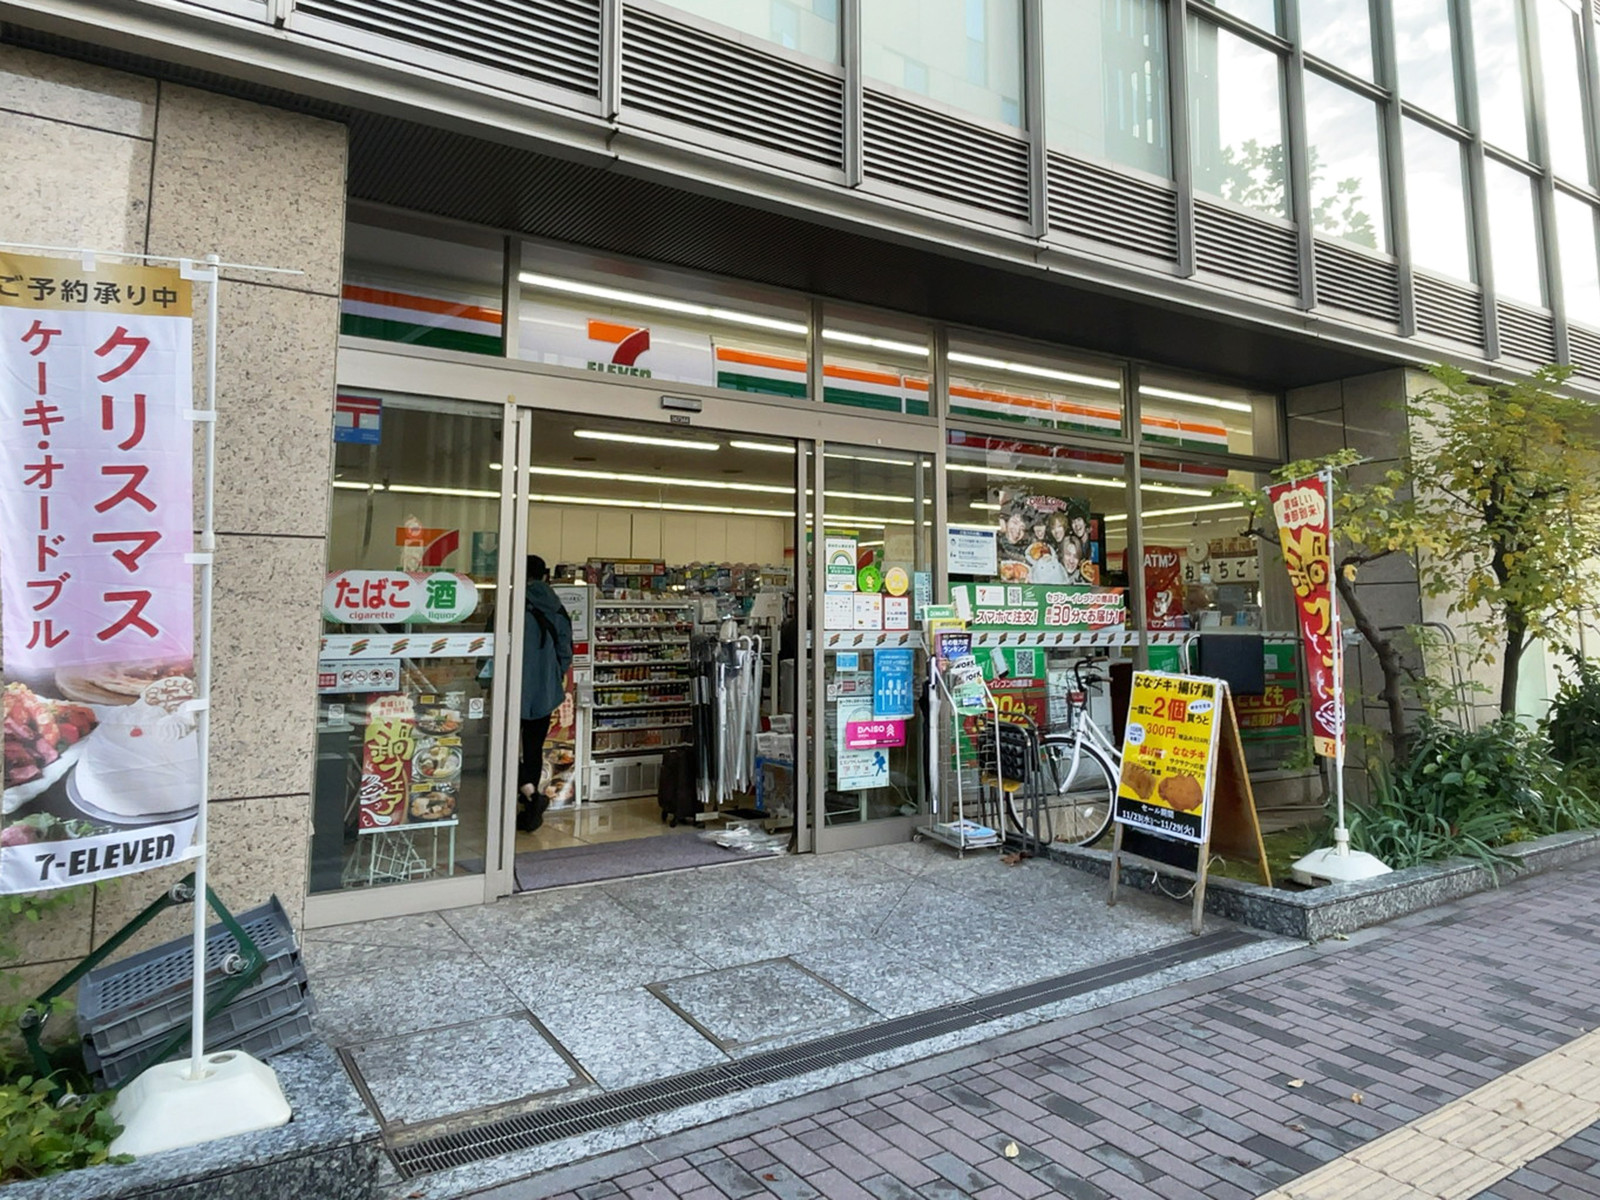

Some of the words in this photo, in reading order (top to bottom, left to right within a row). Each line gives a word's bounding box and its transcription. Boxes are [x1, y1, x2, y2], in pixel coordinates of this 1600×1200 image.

[0, 275, 177, 308] ご予約承り中
[21, 320, 70, 649] ケーキ・オードブル
[92, 326, 162, 641] クリスマス
[1283, 495, 1312, 511] 美味しい
[335, 578, 410, 609] たばこ
[426, 580, 457, 609] 酒
[349, 612, 395, 620] cigarette
[428, 611, 457, 619] liquor
[976, 611, 1038, 625] スマホで注文!
[857, 725, 885, 733] DAISO
[1146, 723, 1176, 739] 300円
[1173, 746, 1206, 761] ななチキ
[364, 717, 415, 815] 鍋フェア
[1141, 804, 1175, 819] セール期間
